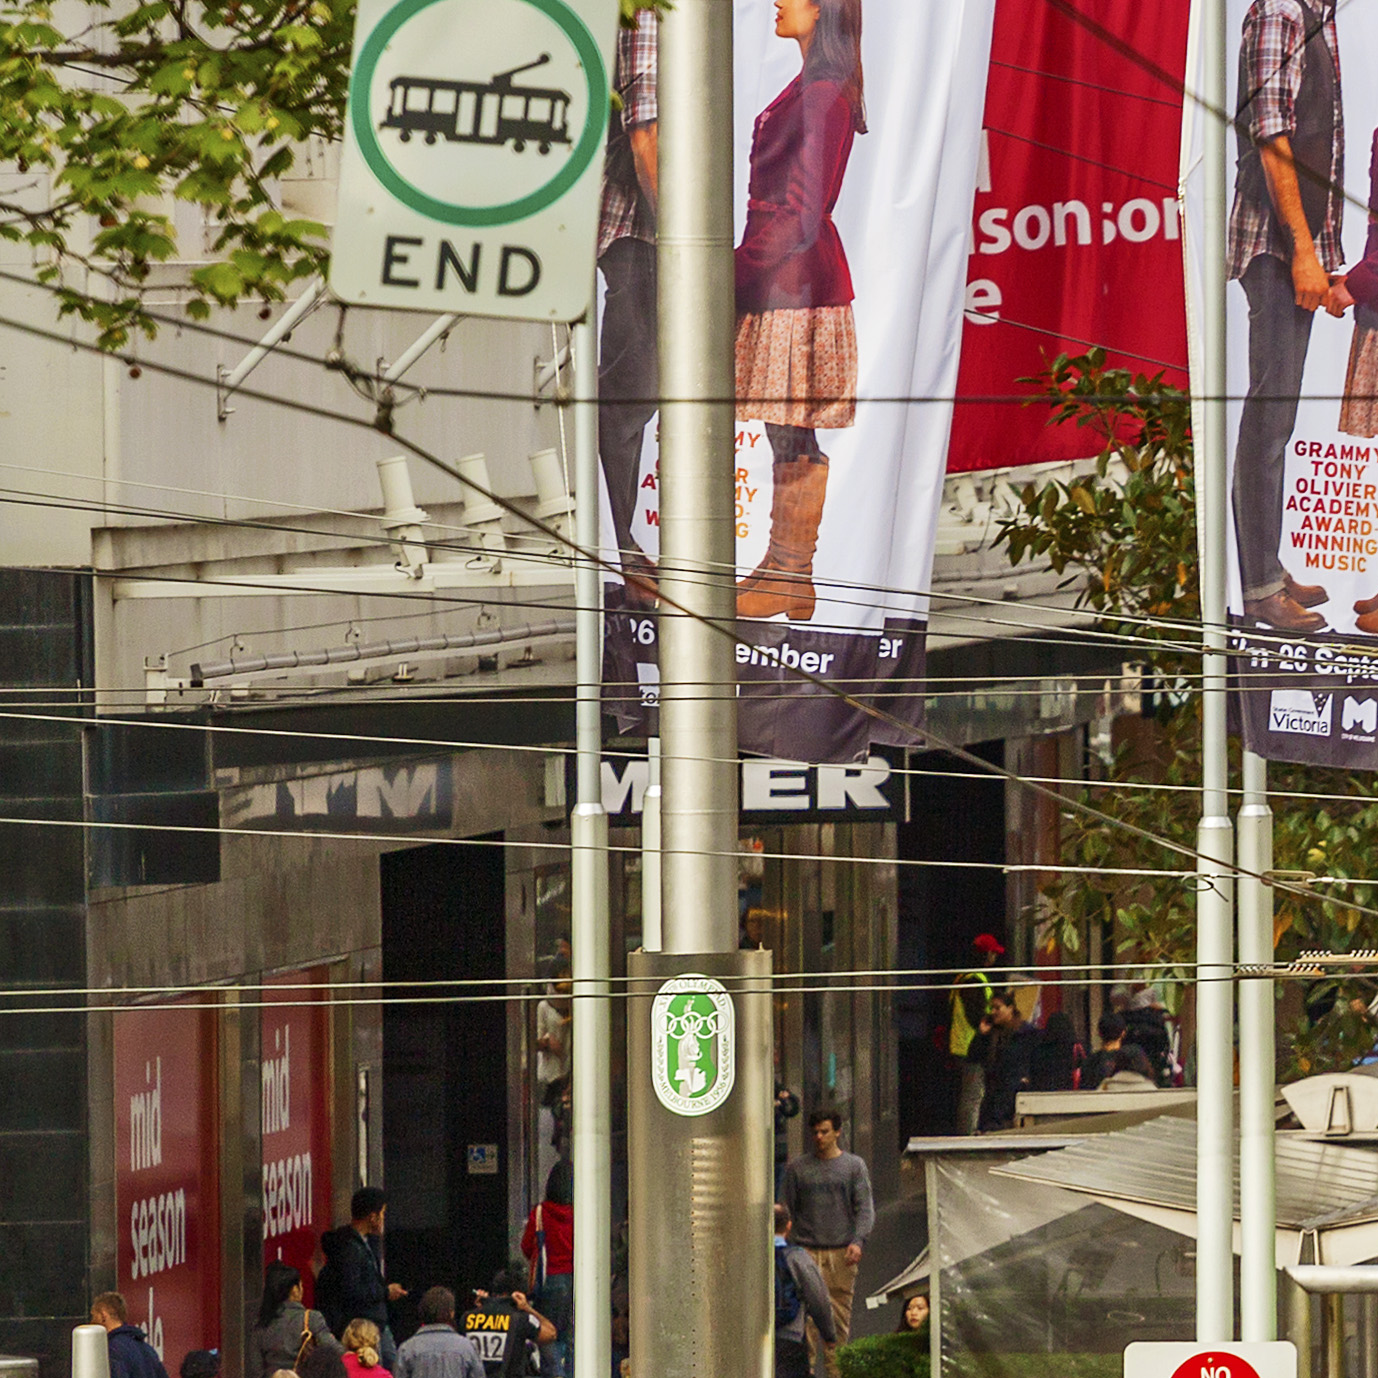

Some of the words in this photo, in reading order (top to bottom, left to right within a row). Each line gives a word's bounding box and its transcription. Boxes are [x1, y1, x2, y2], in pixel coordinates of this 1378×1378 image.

[978, 200, 1092, 255] son
[381, 234, 543, 297] END
[1310, 460, 1366, 480] TONY
[1296, 477, 1377, 500] OLIVIER
[1301, 515, 1378, 536] AWARD-
[1291, 531, 1378, 555] WINNING
[1305, 552, 1367, 573] MUSIC
[1279, 644, 1309, 672] 26
[1272, 712, 1328, 734] Victoria
[600, 757, 890, 814] MER
[262, 1024, 290, 1135] mid
[131, 1056, 163, 1173] mid
[263, 1152, 313, 1241] season
[131, 1188, 186, 1280] season
[465, 1312, 510, 1332] SPAIN
